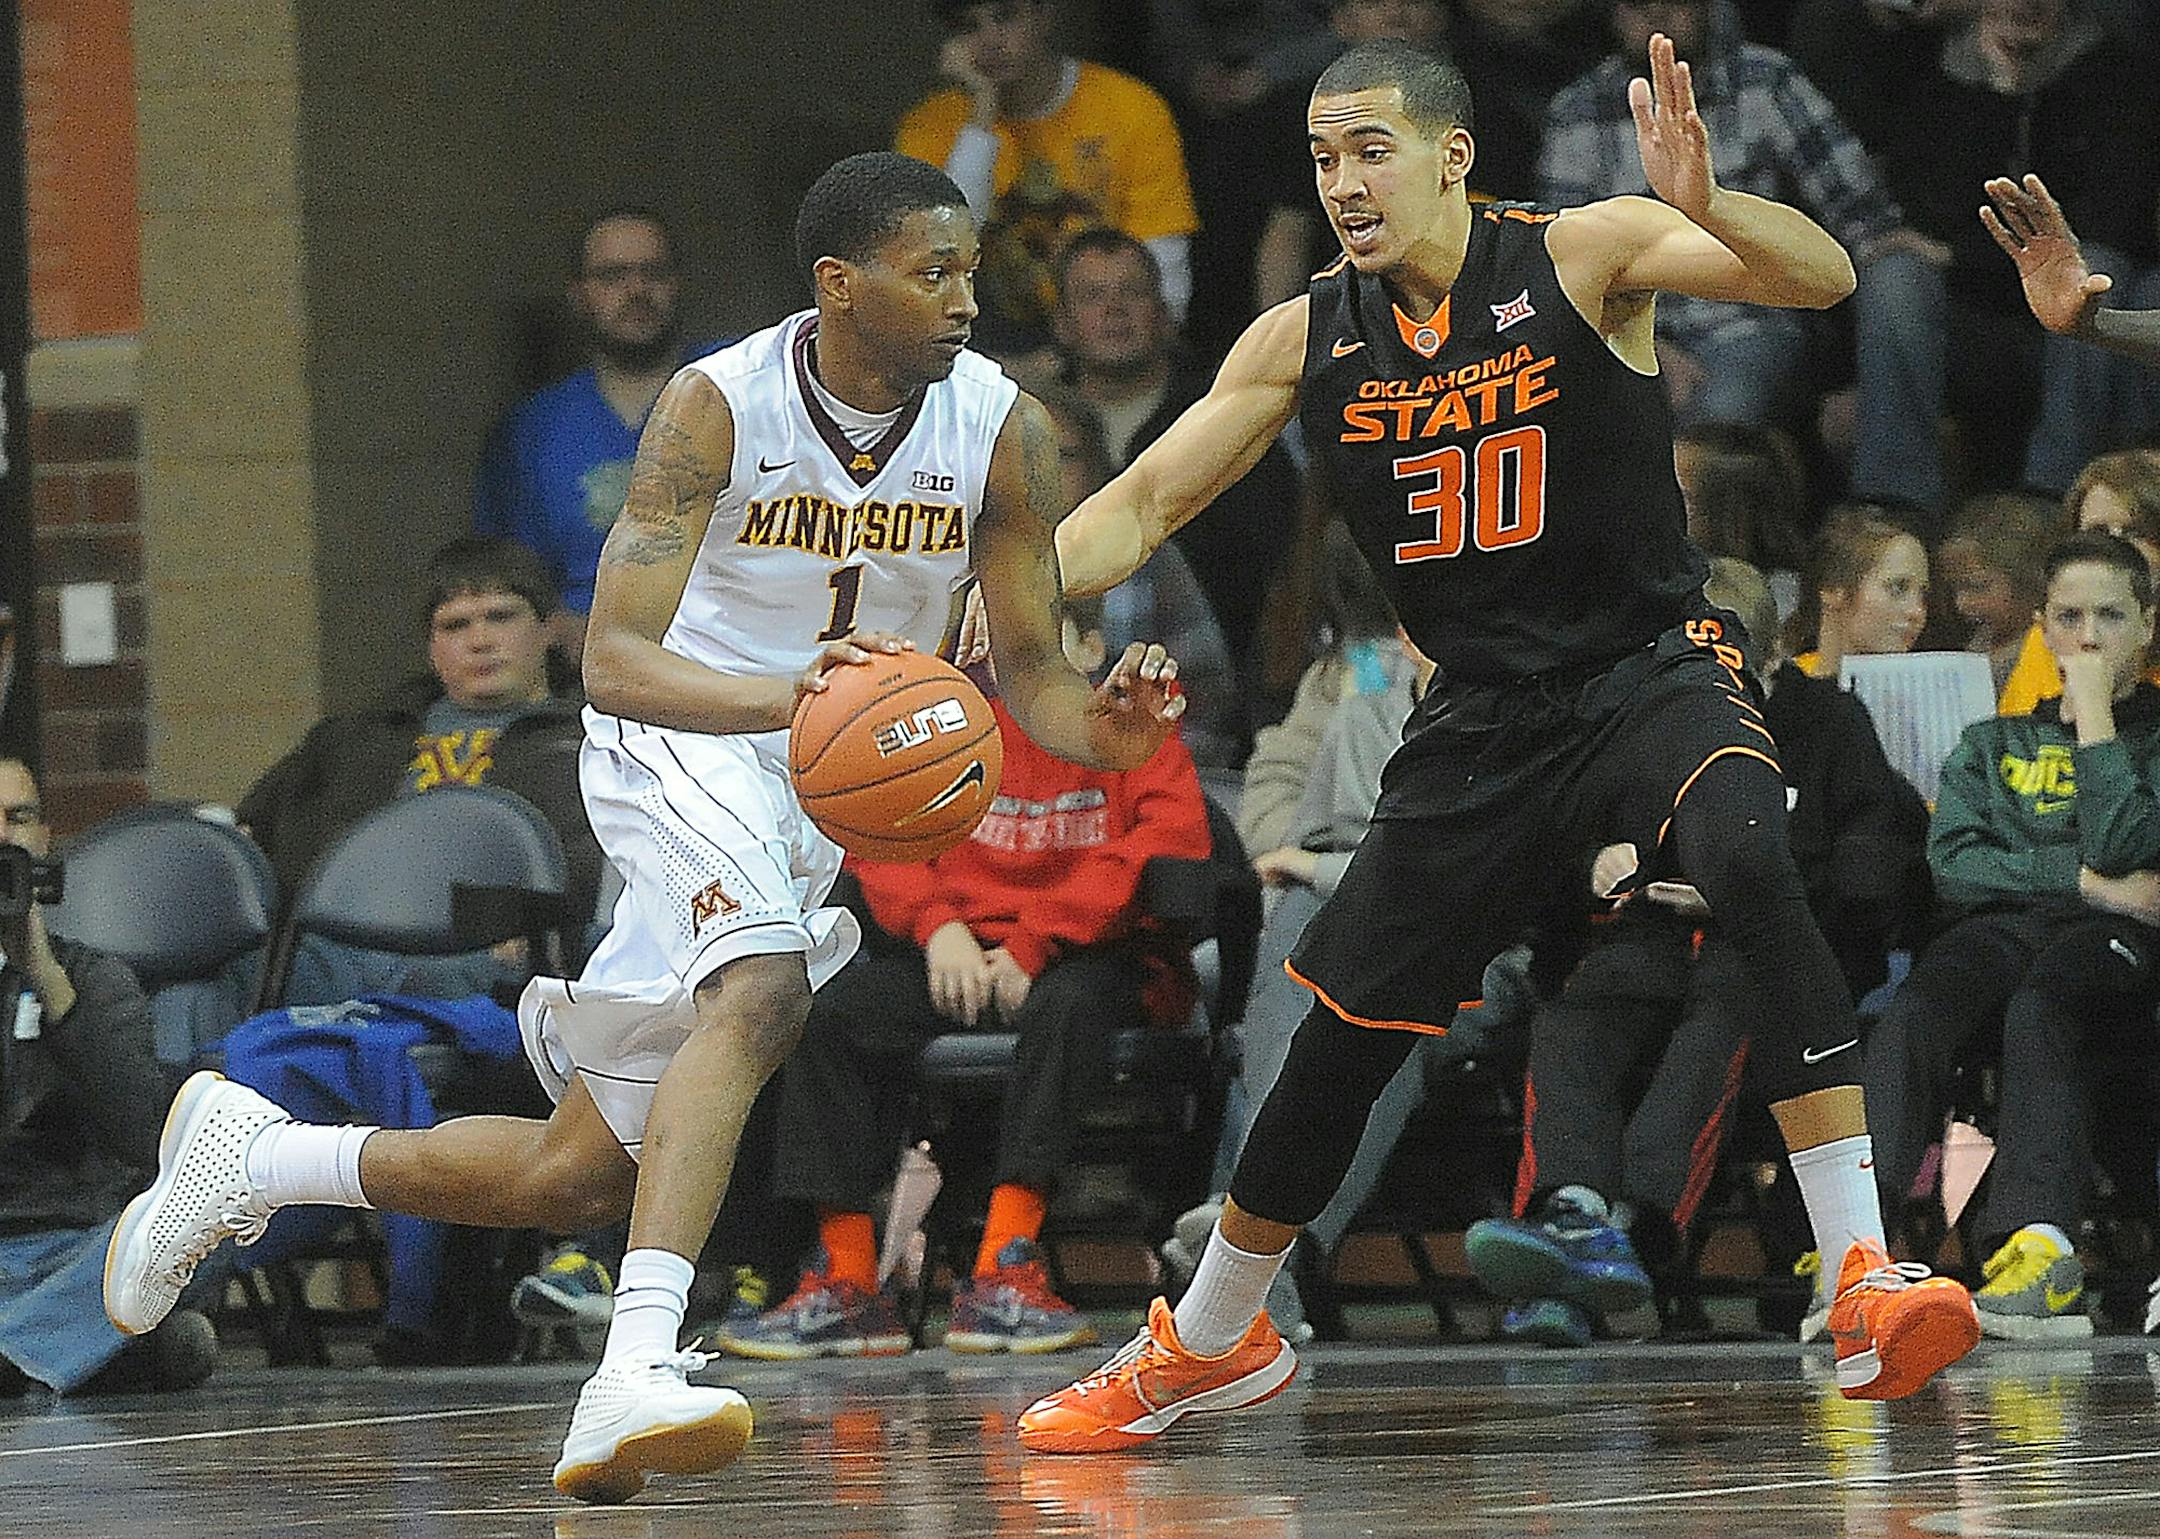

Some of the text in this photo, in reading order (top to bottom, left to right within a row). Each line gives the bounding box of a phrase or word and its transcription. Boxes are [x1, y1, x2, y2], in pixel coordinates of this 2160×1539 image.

[1340, 355, 1560, 443] STATE
[1358, 344, 1535, 399] OKLAHOMA
[736, 493, 967, 560] MINNESOTA
[1393, 425, 1547, 565] 30
[815, 565, 865, 644] 1
